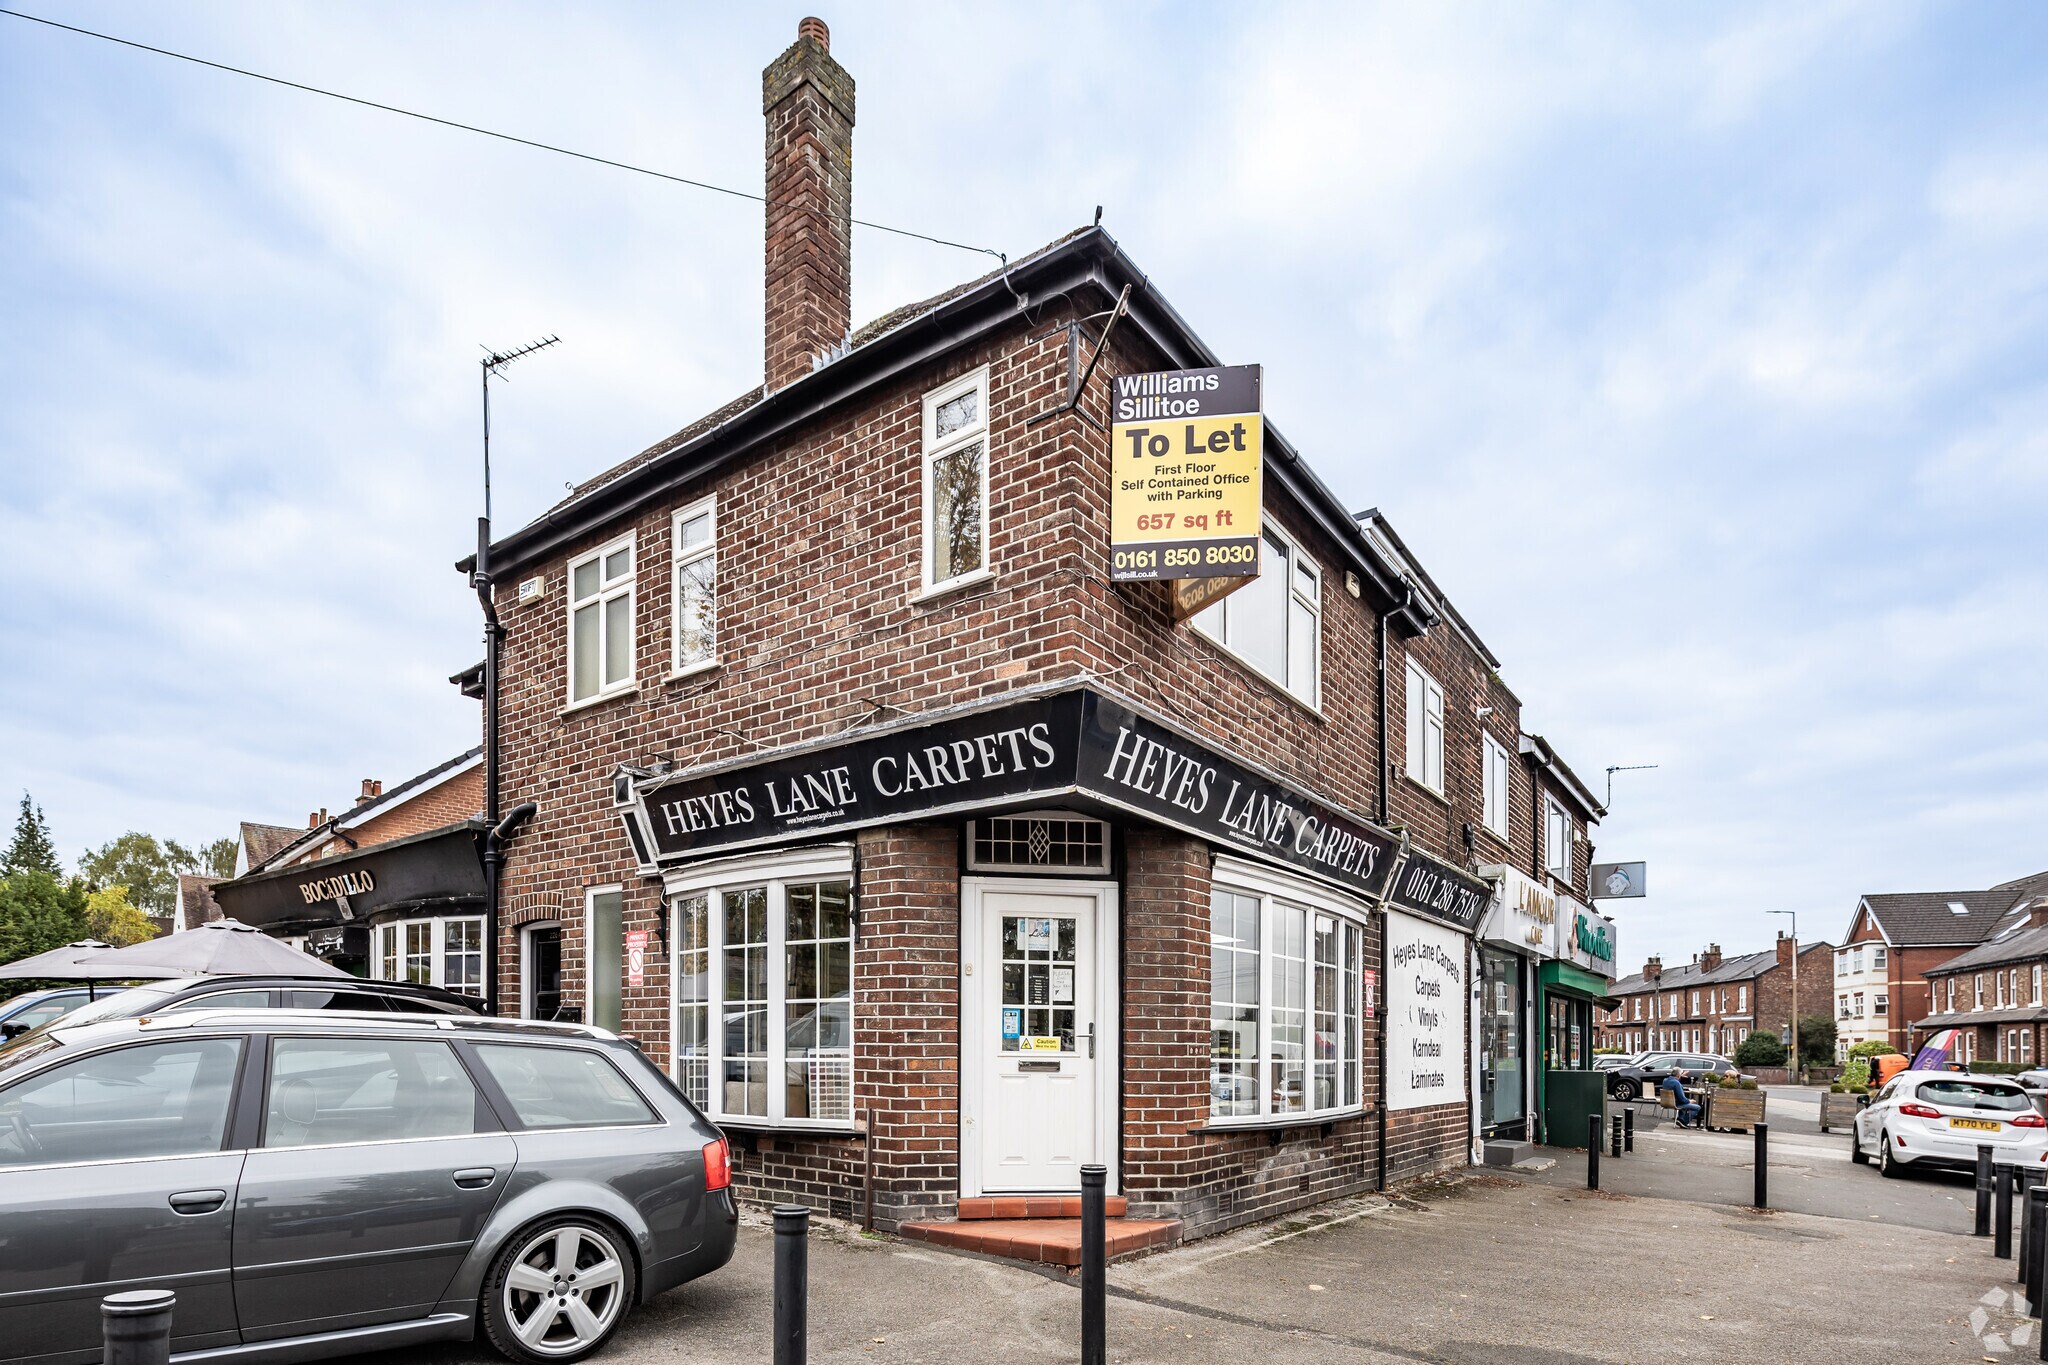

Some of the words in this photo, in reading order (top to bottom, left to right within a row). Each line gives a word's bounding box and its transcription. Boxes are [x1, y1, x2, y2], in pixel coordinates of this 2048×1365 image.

[1118, 373, 1219, 397] Williams
[1118, 396, 1200, 420] Sillitoe
[1125, 428, 1170, 458] To
[1185, 423, 1246, 455] Let
[1155, 464, 1181, 475] First
[1186, 463, 1216, 473] Floor
[1121, 480, 1144, 490] Self
[1148, 476, 1209, 489] Contained
[1213, 474, 1250, 485] Office
[1147, 491, 1172, 501] with
[1177, 489, 1223, 500] Parking
[1137, 513, 1175, 531] 657
[1183, 514, 1208, 531] sq
[1215, 510, 1233, 526] ft
[1114, 550, 1157, 569] 0161
[1164, 547, 1200, 566] 850
[1205, 545, 1255, 565] 8030
[660, 787, 756, 836] HEYES
[764, 766, 858, 819] LANE
[872, 722, 1056, 797] CARPETS
[1103, 726, 1218, 814] HEYES
[1218, 779, 1293, 846] LANE
[1294, 815, 1381, 880] CARPETS
[1405, 867, 1438, 904] 0161
[1431, 879, 1459, 911] 286
[1451, 887, 1480, 920] 7518
[1392, 943, 1416, 969] Heyes
[1417, 938, 1434, 961] Lane
[1436, 944, 1460, 984] Carpets
[1415, 974, 1441, 1000] Carpets
[1418, 1006, 1438, 1031] Vinyls
[1411, 1069, 1445, 1090] Laminates
[1979, 1121, 1997, 1130] YLP
